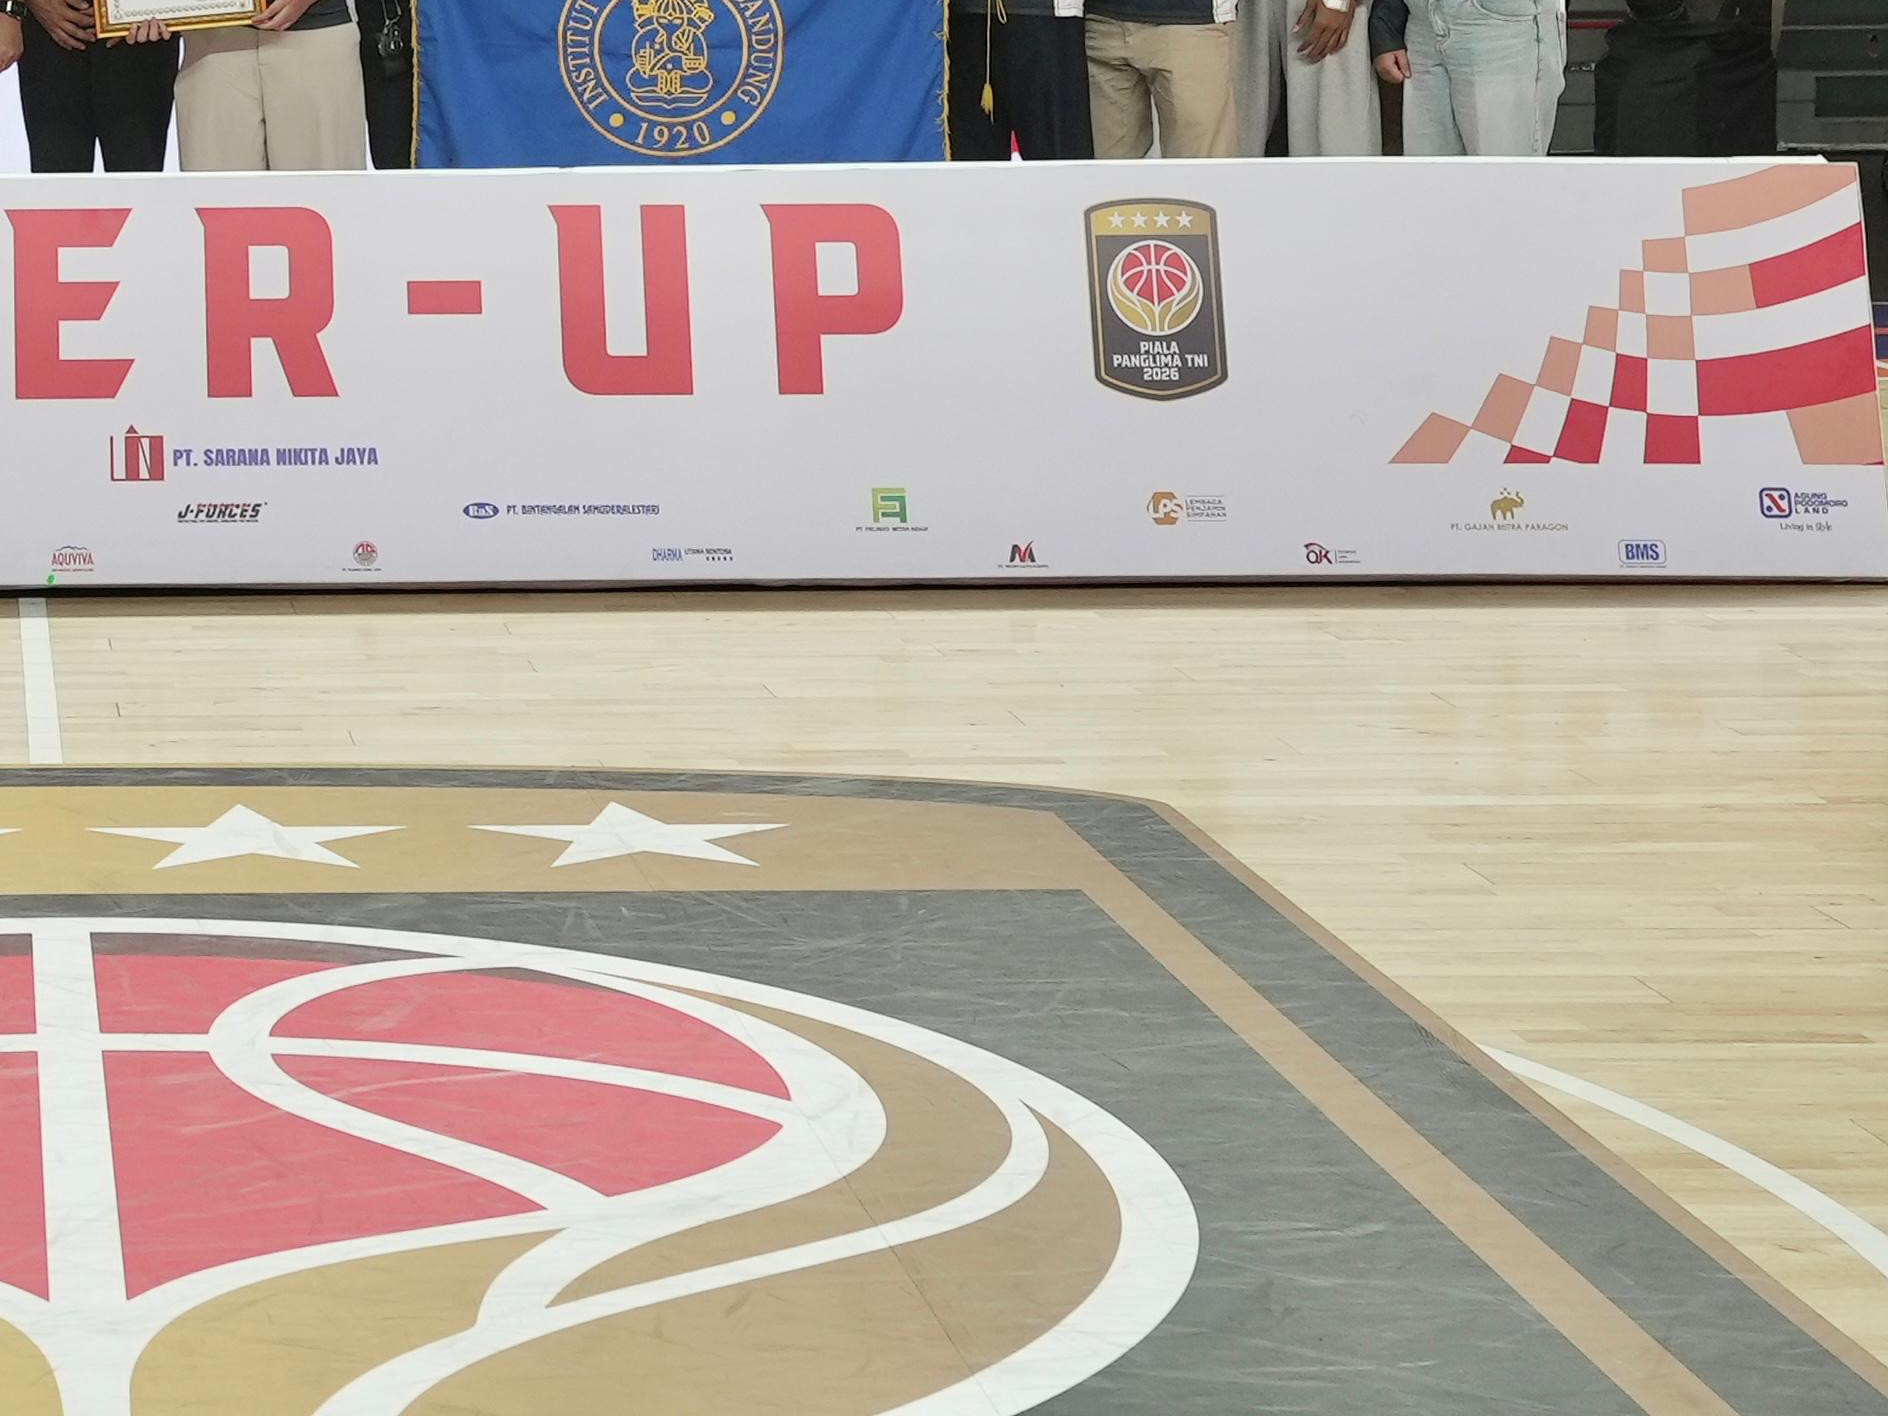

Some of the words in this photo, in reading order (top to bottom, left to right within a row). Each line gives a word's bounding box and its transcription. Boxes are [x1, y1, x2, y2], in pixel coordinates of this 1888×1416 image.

[634, 121, 711, 150] 1920
[1139, 341, 1180, 354] PIALA
[1113, 354, 1182, 367] PANGLIMA
[1185, 355, 1208, 367] TNI
[1143, 368, 1180, 381] 2026
[172, 449, 199, 467] PT.
[203, 448, 271, 467] SARANA
[276, 448, 330, 466] NIKITA
[335, 447, 379, 466] JAYA
[1795, 507, 1829, 515] LAND
[1624, 543, 1660, 561] BMS
